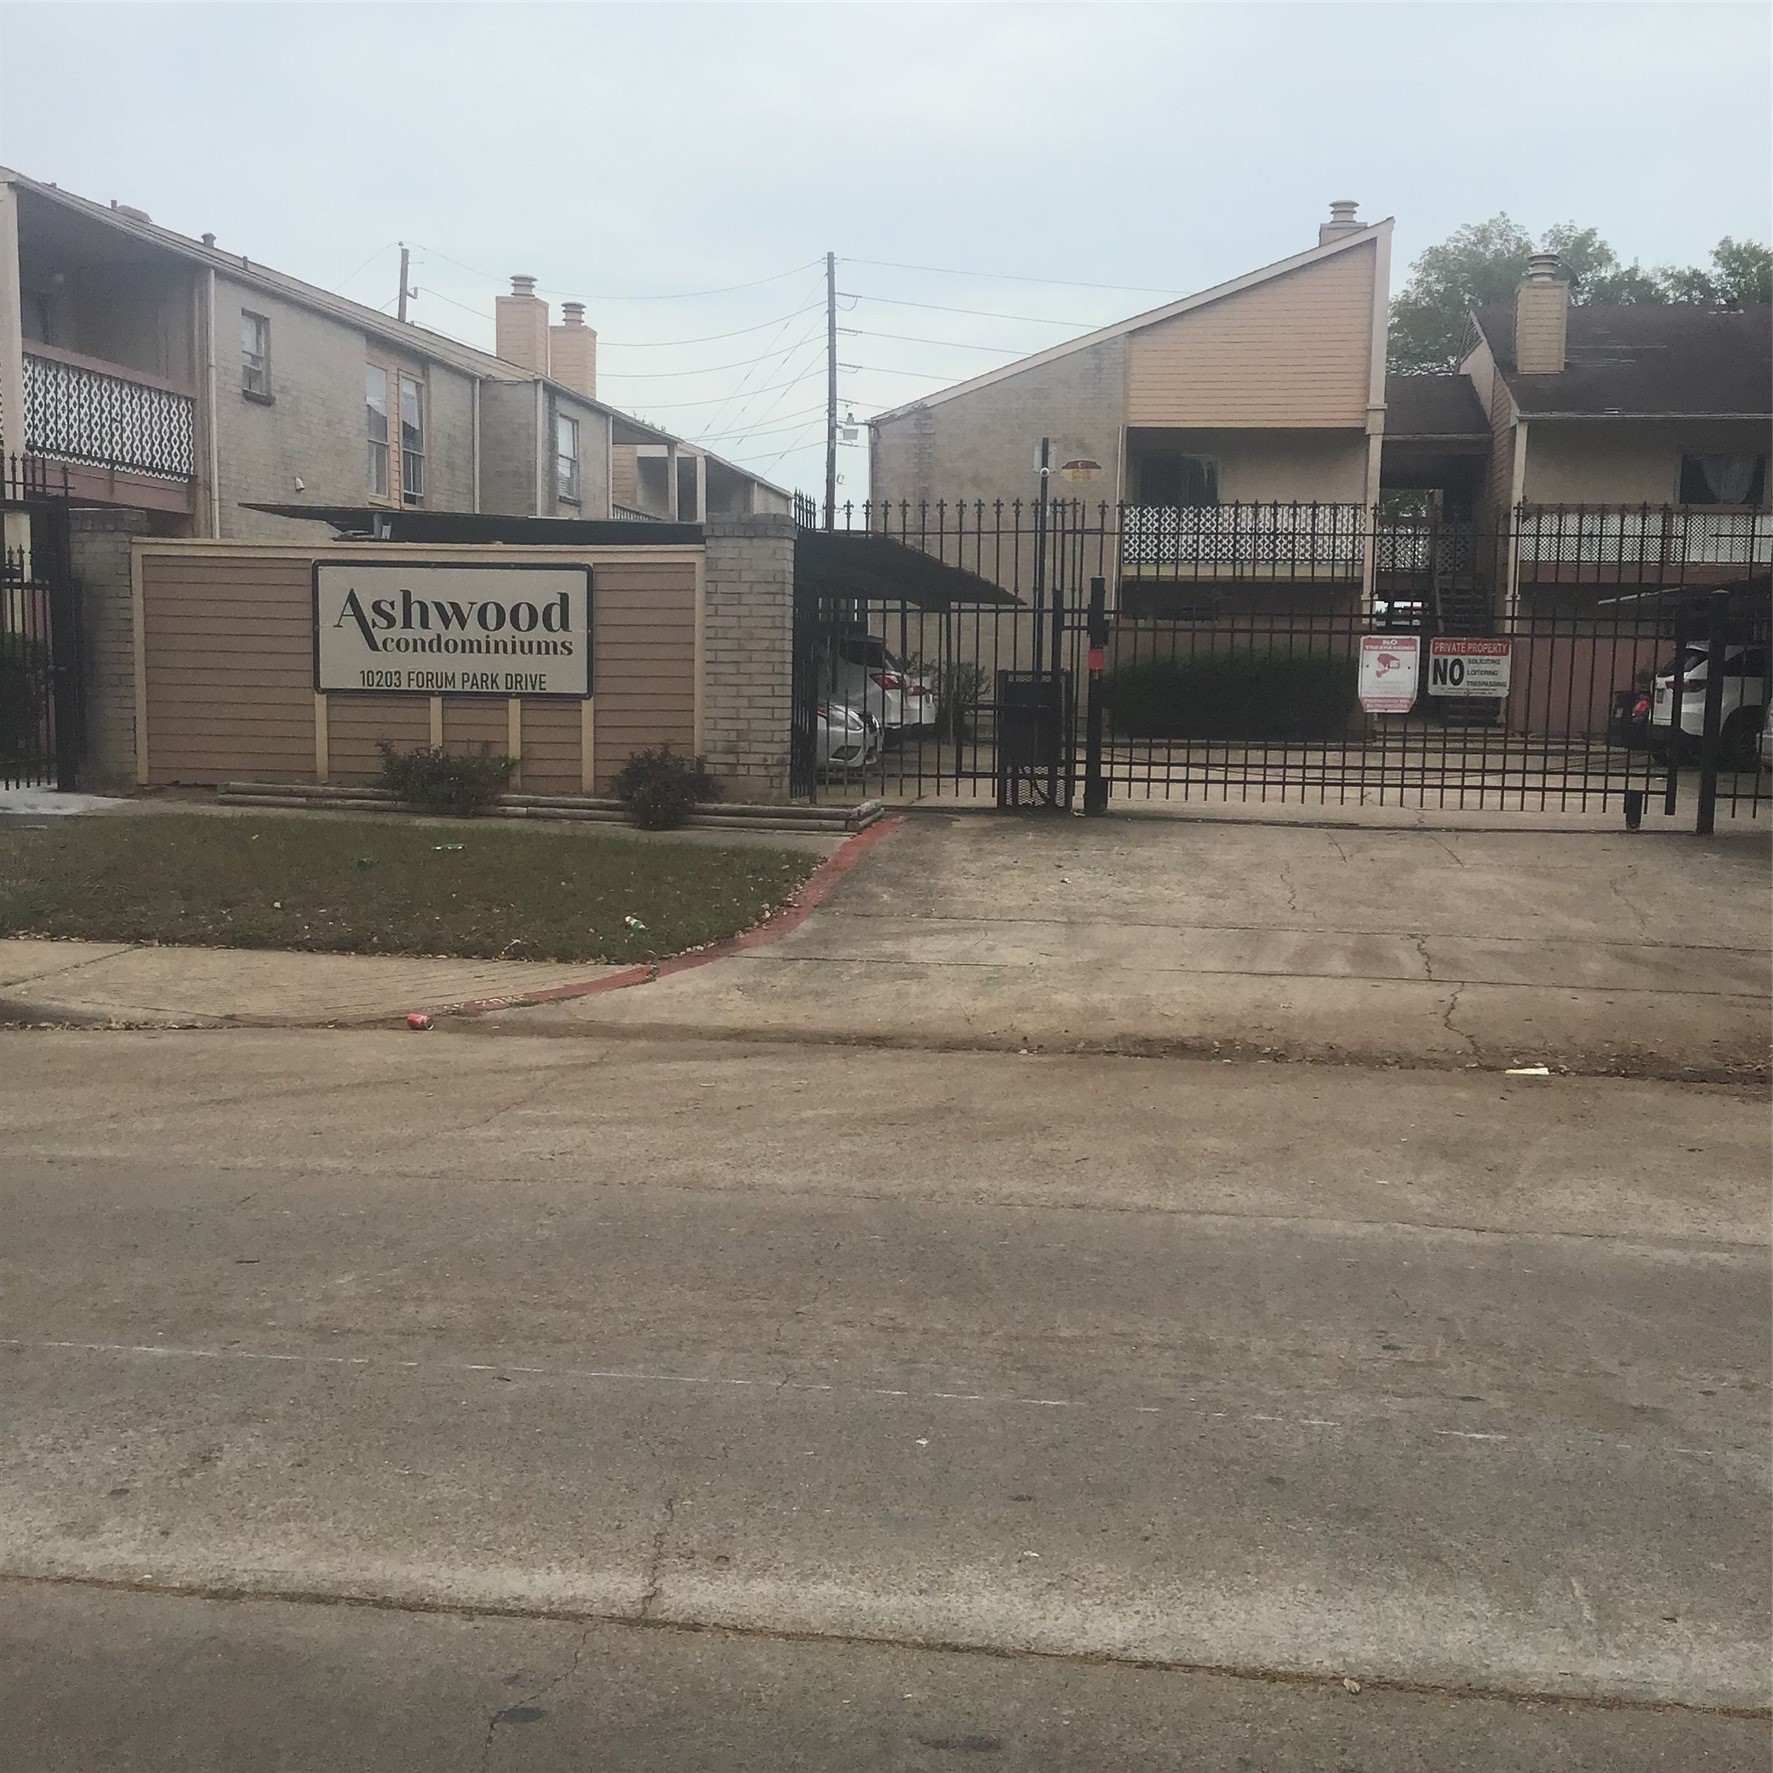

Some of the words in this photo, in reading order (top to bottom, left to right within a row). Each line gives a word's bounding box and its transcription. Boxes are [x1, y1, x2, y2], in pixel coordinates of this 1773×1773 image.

[333, 587, 572, 652] Ashwood
[382, 633, 574, 656] condominiums
[1434, 642, 1466, 653] PRIVATE
[1467, 642, 1508, 654] PROPERTY
[359, 670, 402, 688] 10203
[407, 671, 456, 689] FORUM
[461, 672, 500, 690] PARK
[505, 673, 547, 691] DRIVE
[1432, 658, 1465, 686] NO
